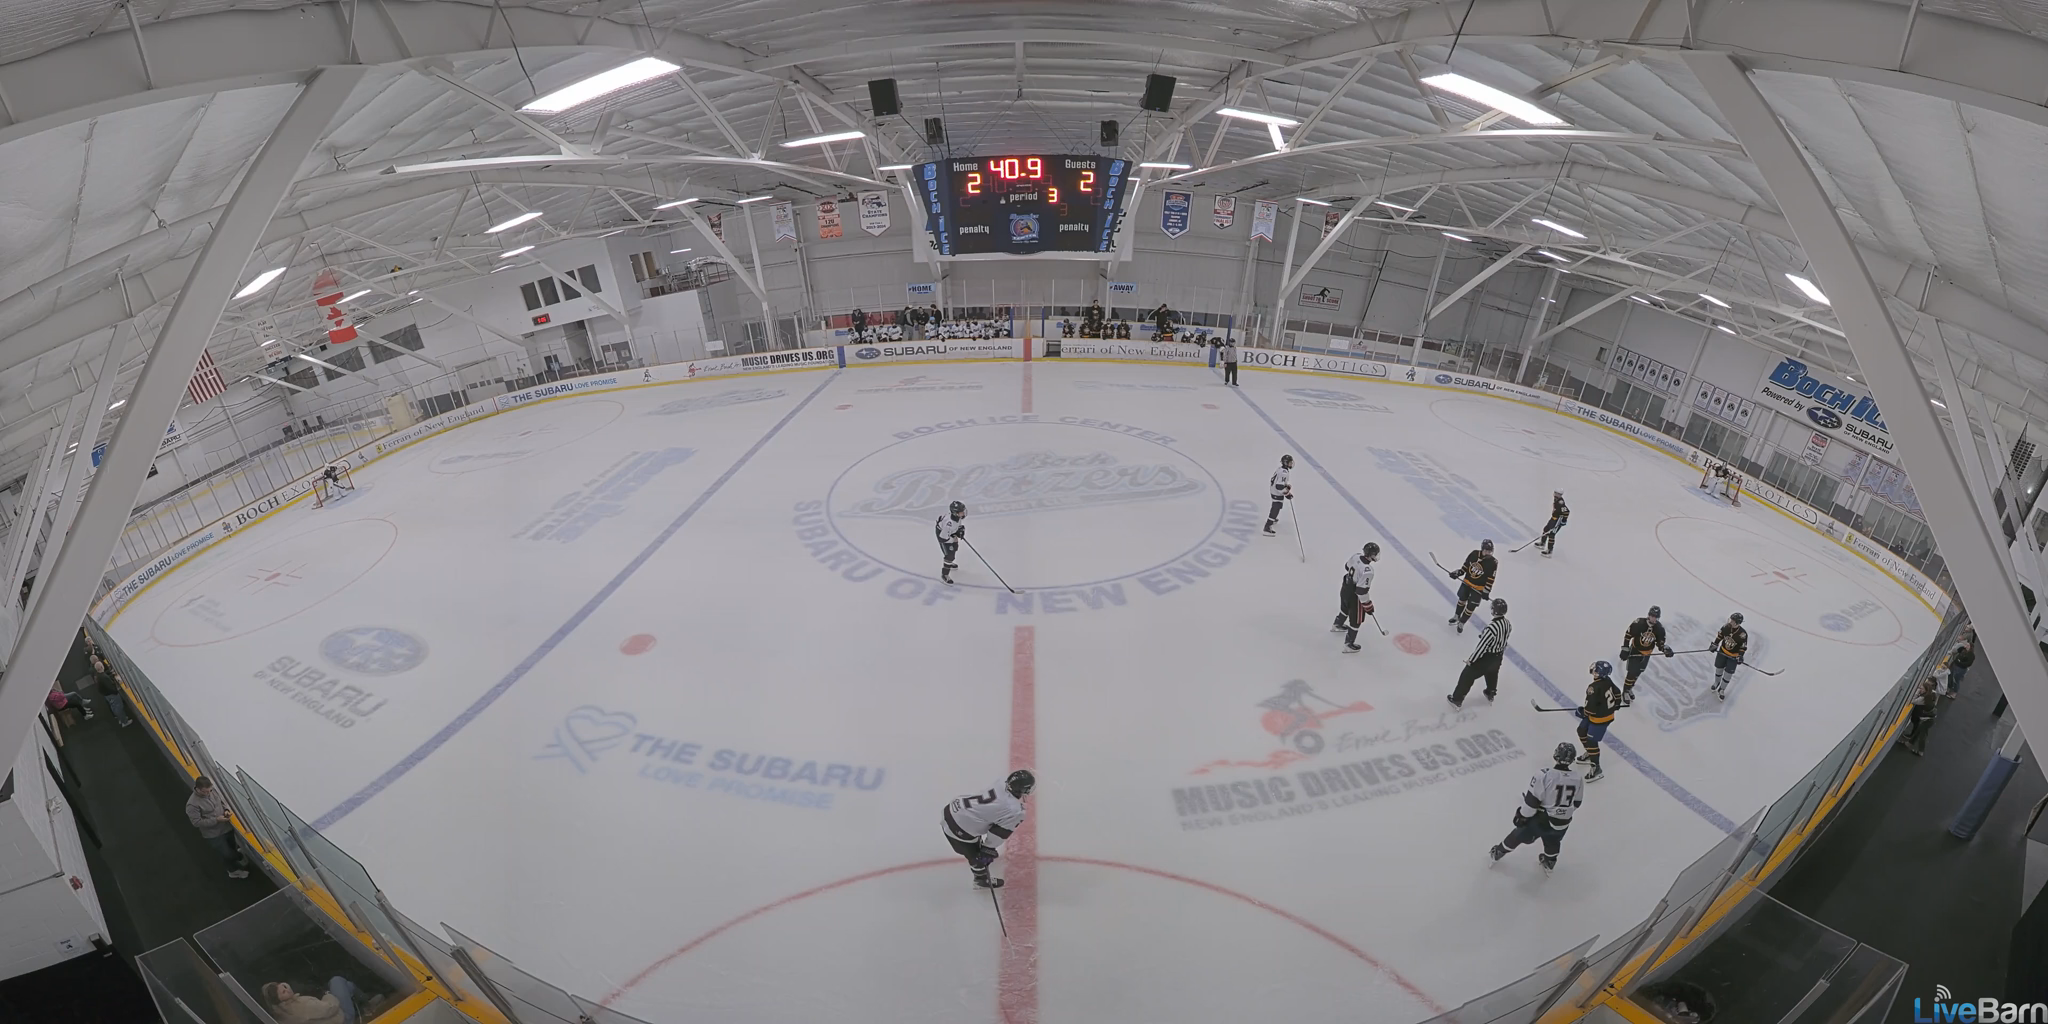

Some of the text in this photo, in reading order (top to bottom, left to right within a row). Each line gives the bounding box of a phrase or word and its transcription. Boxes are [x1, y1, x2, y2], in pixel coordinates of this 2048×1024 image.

[953, 162, 978, 172] Home
[990, 159, 1041, 179] 40.9
[1065, 159, 1096, 169] Guests
[967, 173, 981, 194] 2
[1080, 171, 1094, 192] 2
[1009, 192, 1038, 203] period
[1048, 187, 1058, 203] 3
[959, 225, 990, 236] penalty
[1059, 223, 1090, 232] penalty
[911, 284, 933, 292] HOME
[741, 349, 835, 367] MUSIC DRIVES US.ORG
[883, 345, 948, 357] SUBARU
[1061, 344, 1201, 359] errari of New England
[1242, 351, 1380, 375] BOCH EXOTICS
[513, 377, 618, 403] THE SUBARU LOVE PROMISE
[1453, 377, 1496, 391] SUBARU
[1768, 357, 1856, 414] BOCH
[1761, 386, 1805, 411] Powered by
[382, 405, 485, 450] Ferrari of New England
[891, 414, 1178, 446] BOCH ICE CENTER
[1577, 405, 1684, 453] THE SUBARU LOVE PROMISE
[1845, 423, 1894, 451] SUBARU
[1851, 433, 1864, 444] NEW
[1864, 440, 1890, 455] ENGLAND
[235, 495, 281, 526] BOCH
[1744, 478, 1812, 520] EXOTICS
[122, 532, 215, 597] THE SUBARU LOVE PROMISE
[792, 499, 1259, 616] SUBARU OF NEW ENGLAND
[1853, 537, 1937, 600] Ferrari of New England
[266, 655, 389, 717] SUBARU
[268, 678, 296, 695] NEW
[290, 690, 356, 729] ENGLAND
[630, 732, 885, 791] THE SUBARU
[1171, 728, 1517, 817] MUSIC DRIVES US.ORG
[638, 762, 835, 810] LOVE PROMISE
[1179, 749, 1527, 832] NEW ENGLAND'S LEADING MUSIC FOUNDATION
[1554, 784, 1576, 808] 13
